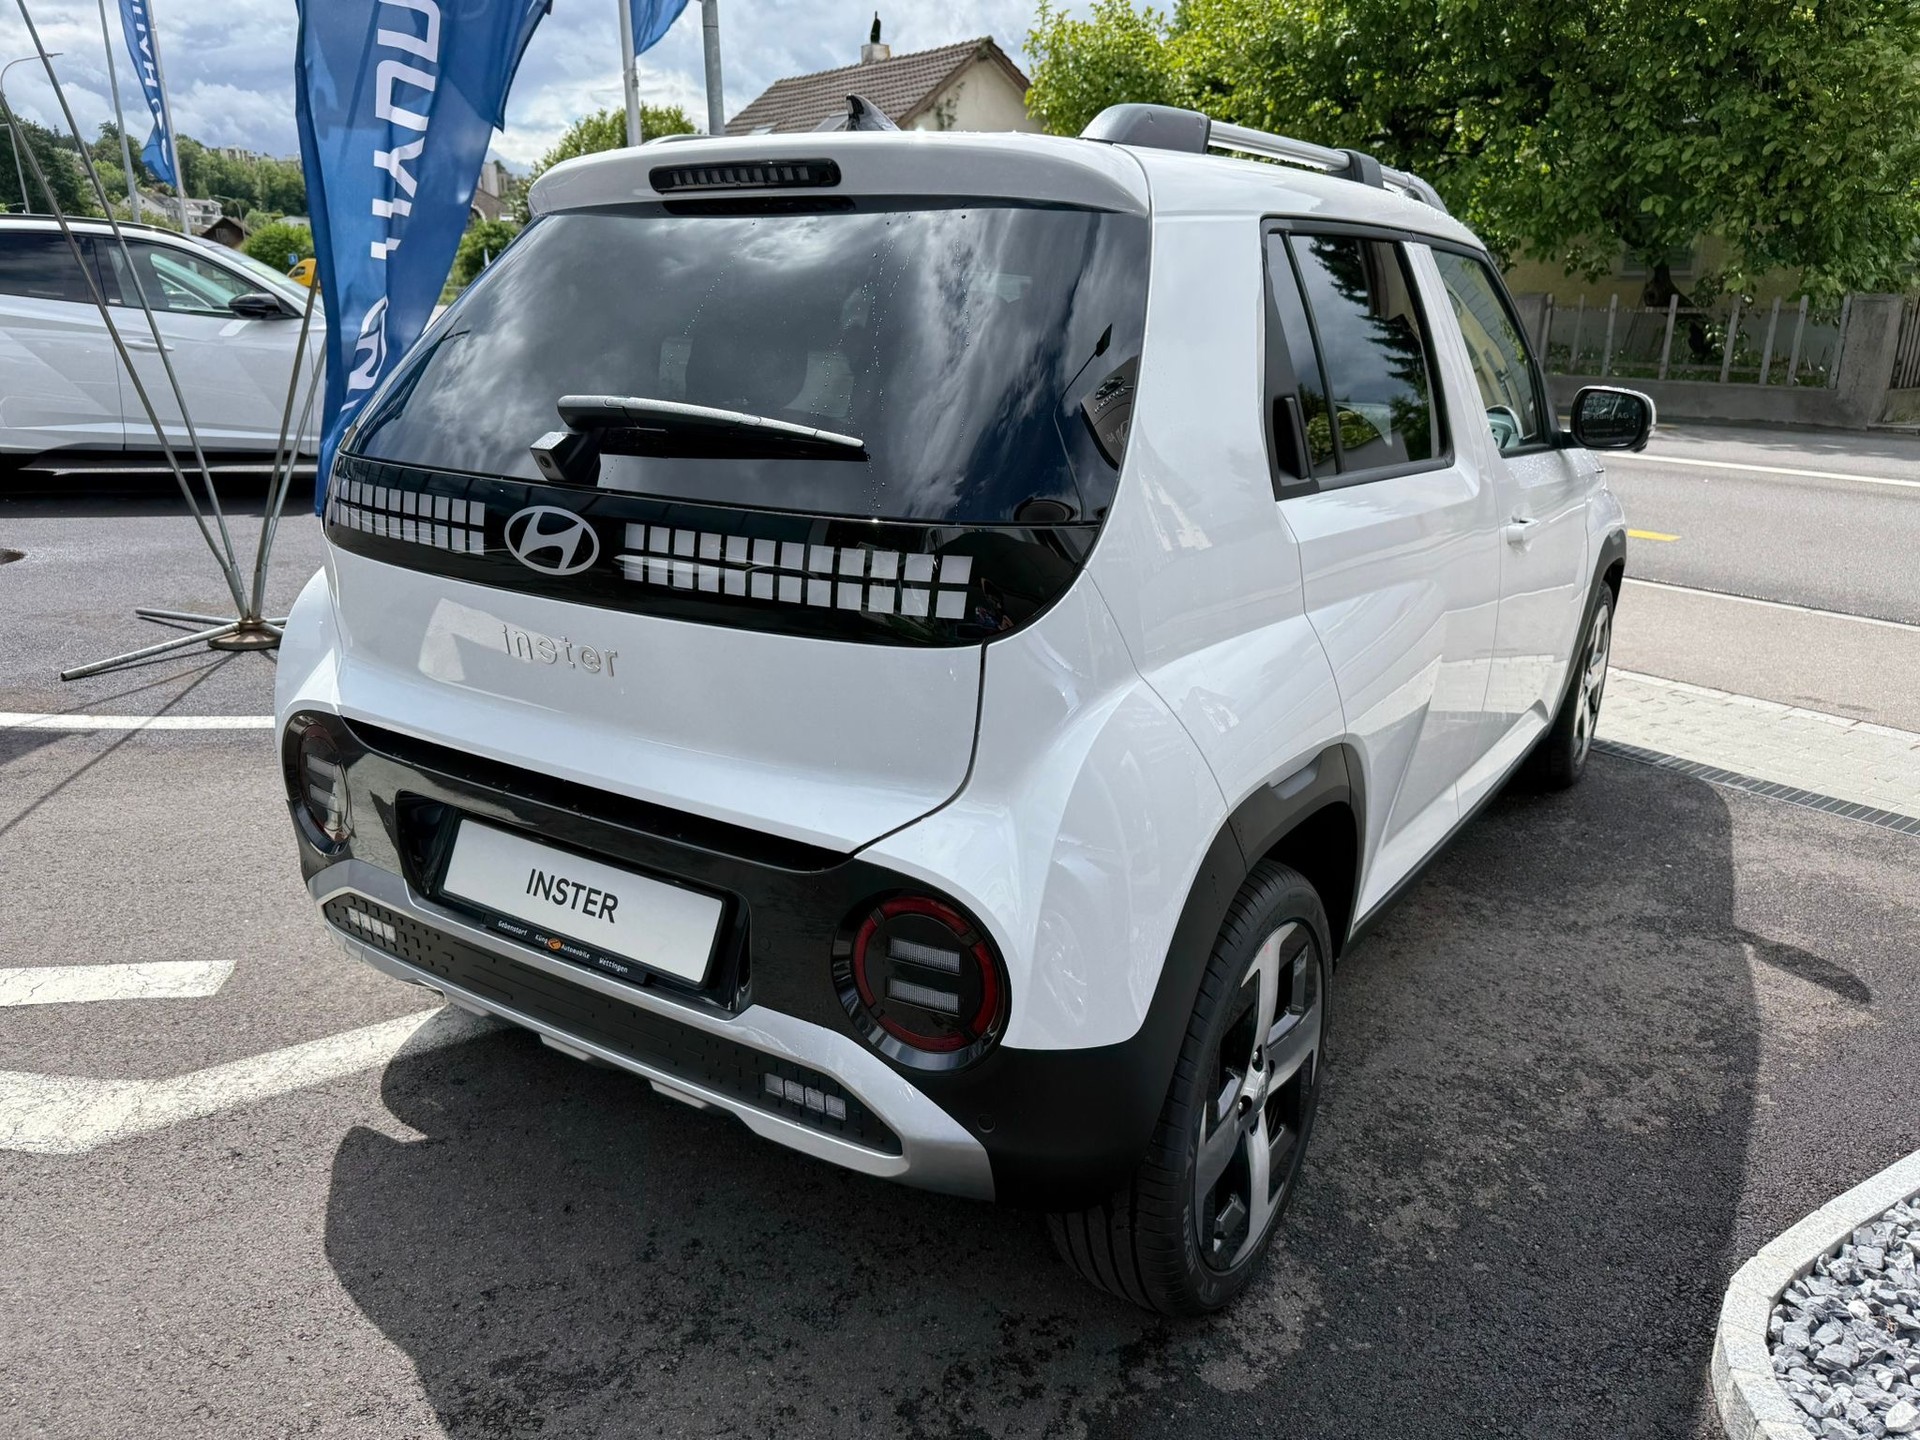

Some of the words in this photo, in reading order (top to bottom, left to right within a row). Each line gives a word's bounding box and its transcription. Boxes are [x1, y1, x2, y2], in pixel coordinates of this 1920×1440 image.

[501, 623, 619, 678] inster
[526, 869, 618, 924] INSTER
[561, 943, 590, 959] Automobile
[599, 957, 628, 973] Wettingen
